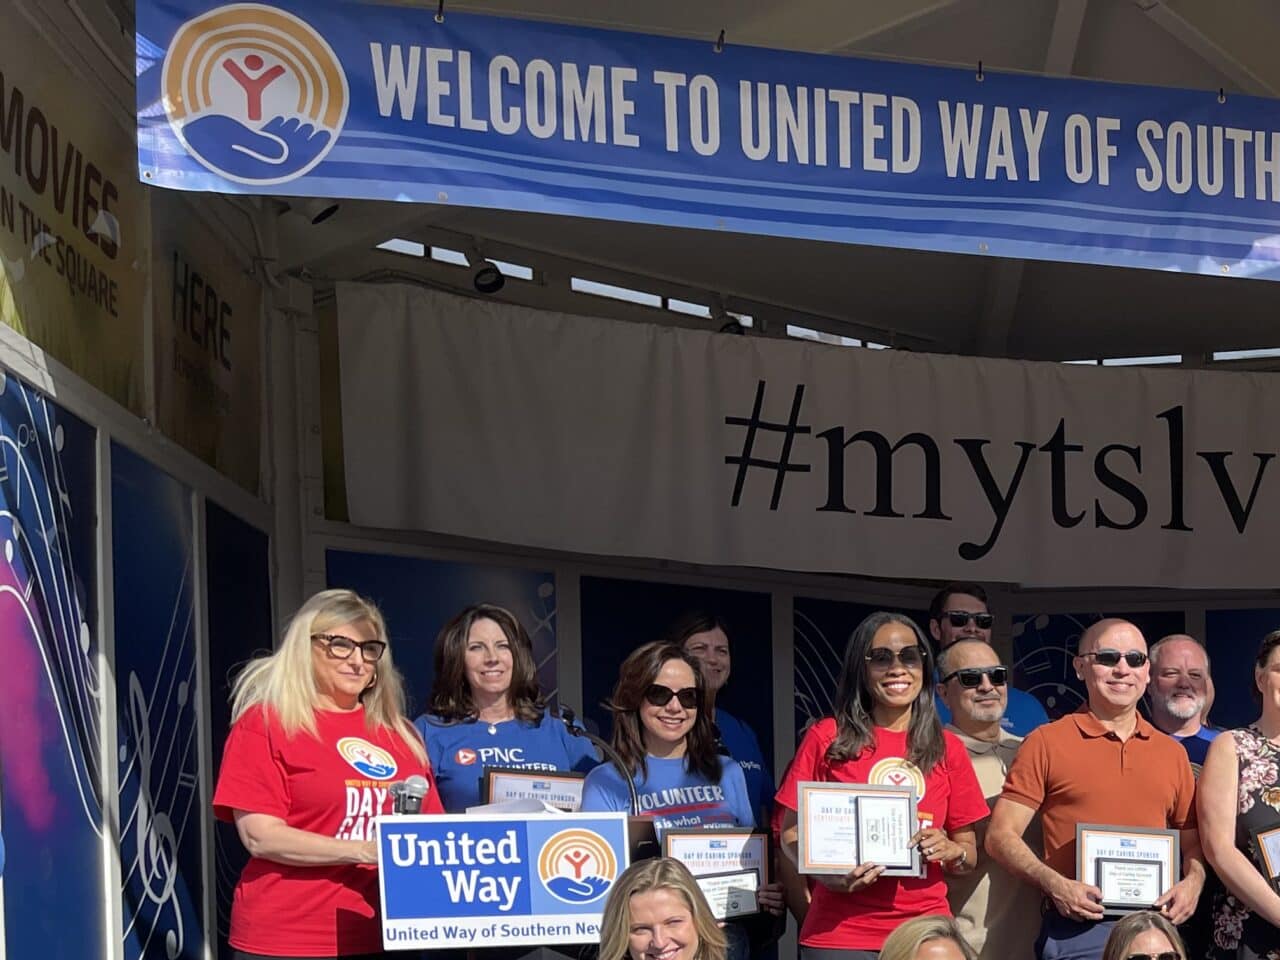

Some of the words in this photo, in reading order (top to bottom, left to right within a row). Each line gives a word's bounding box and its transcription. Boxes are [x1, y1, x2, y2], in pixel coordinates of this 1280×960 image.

[369, 42, 640, 147] WELCOME
[654, 70, 720, 156] TO
[739, 80, 922, 174] UNITED
[938, 100, 1049, 182] WAY
[1065, 113, 1121, 186] OF
[55, 235, 118, 318] SQUARE
[173, 251, 233, 371] HERE
[725, 380, 1277, 561] #mytslv
[478, 747, 525, 763] PNC
[346, 786, 387, 817] DAY
[387, 830, 521, 867] United
[442, 870, 521, 912] Way
[386, 926, 439, 942] United
[443, 926, 477, 943] Way
[481, 925, 496, 938] of
[500, 923, 571, 938] Southern
[575, 922, 601, 936] Nev
